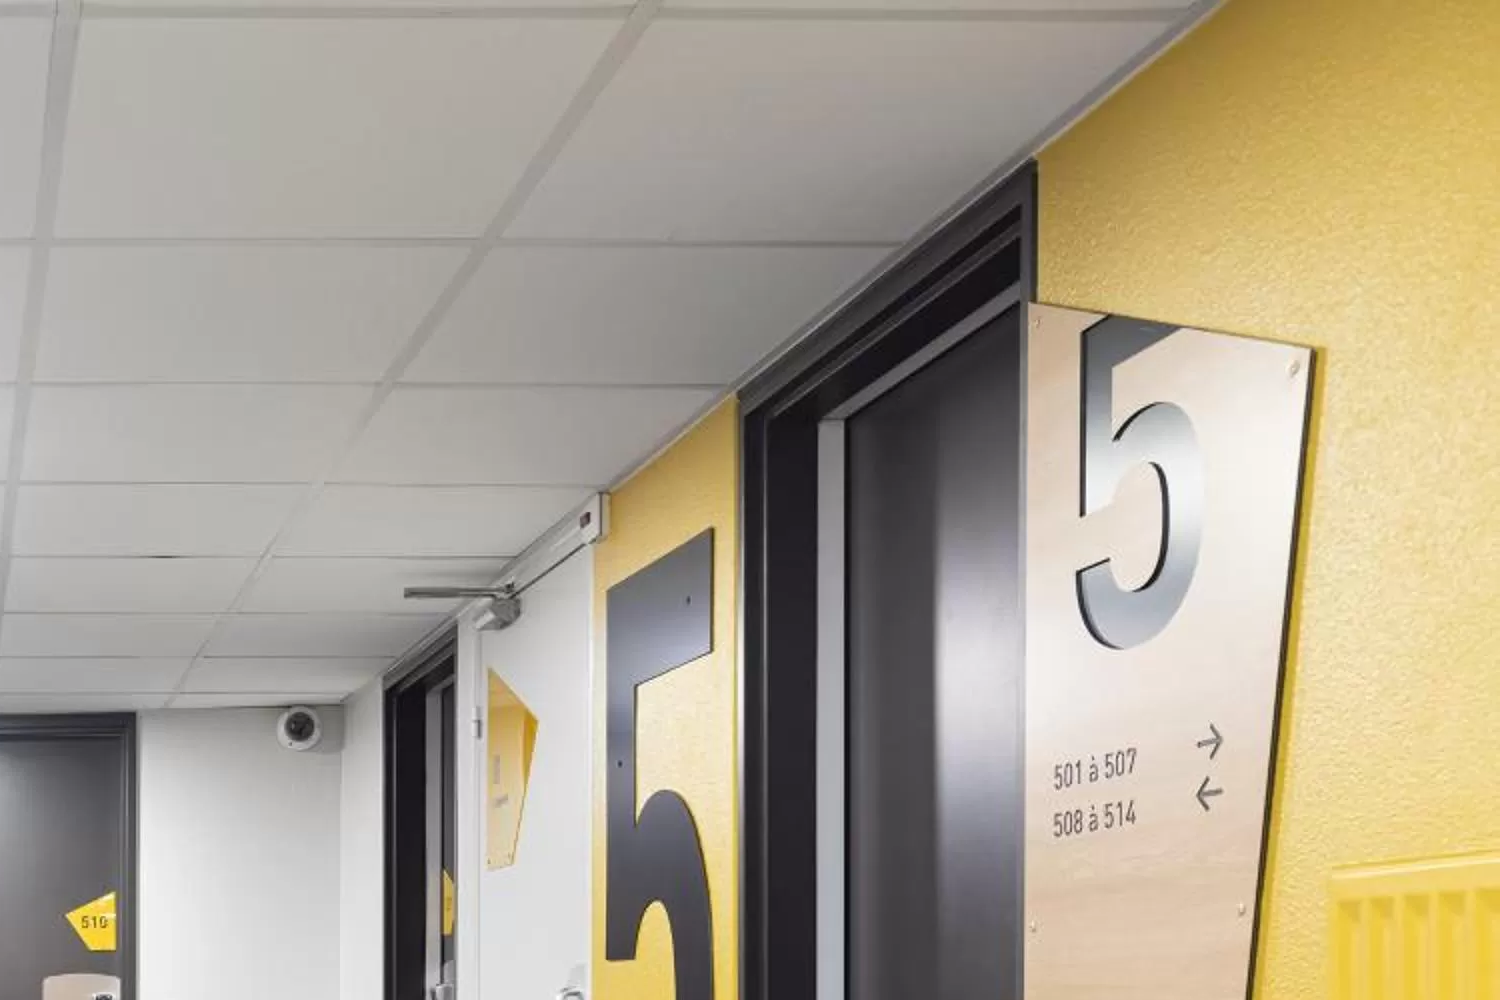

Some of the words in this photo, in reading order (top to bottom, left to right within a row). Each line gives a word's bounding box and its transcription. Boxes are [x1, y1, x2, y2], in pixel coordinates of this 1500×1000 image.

[1076, 315, 1207, 651] 5
[1053, 760, 1082, 791] 501
[1089, 755, 1099, 783] à
[1104, 747, 1137, 779] 507
[1052, 809, 1083, 838] 508
[1088, 804, 1099, 832] à
[1103, 799, 1136, 829] 514
[81, 915, 109, 929] 510
